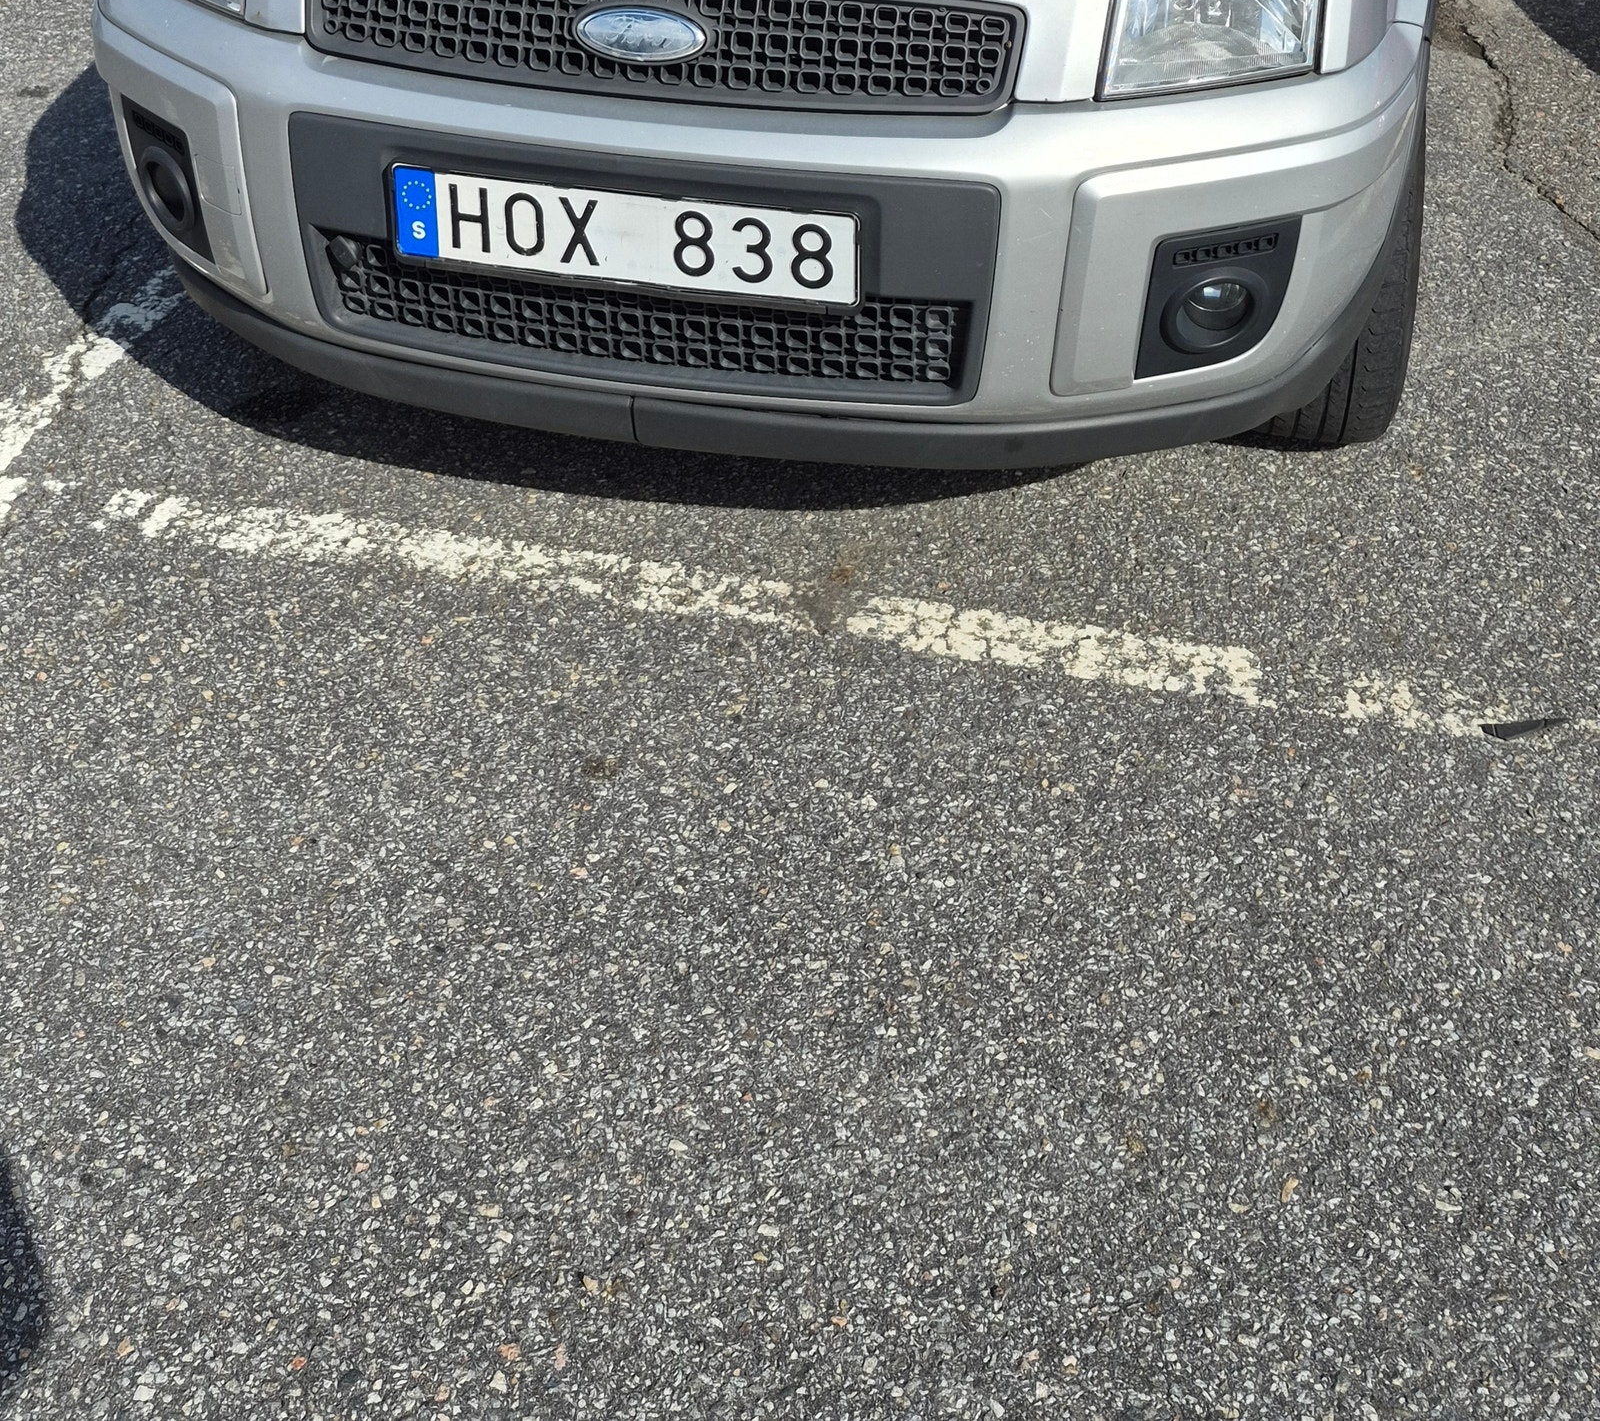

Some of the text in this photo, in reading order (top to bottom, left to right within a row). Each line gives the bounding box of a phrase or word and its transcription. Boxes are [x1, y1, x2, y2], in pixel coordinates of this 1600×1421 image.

[412, 220, 426, 239] S
[448, 182, 834, 289] HOX 838
